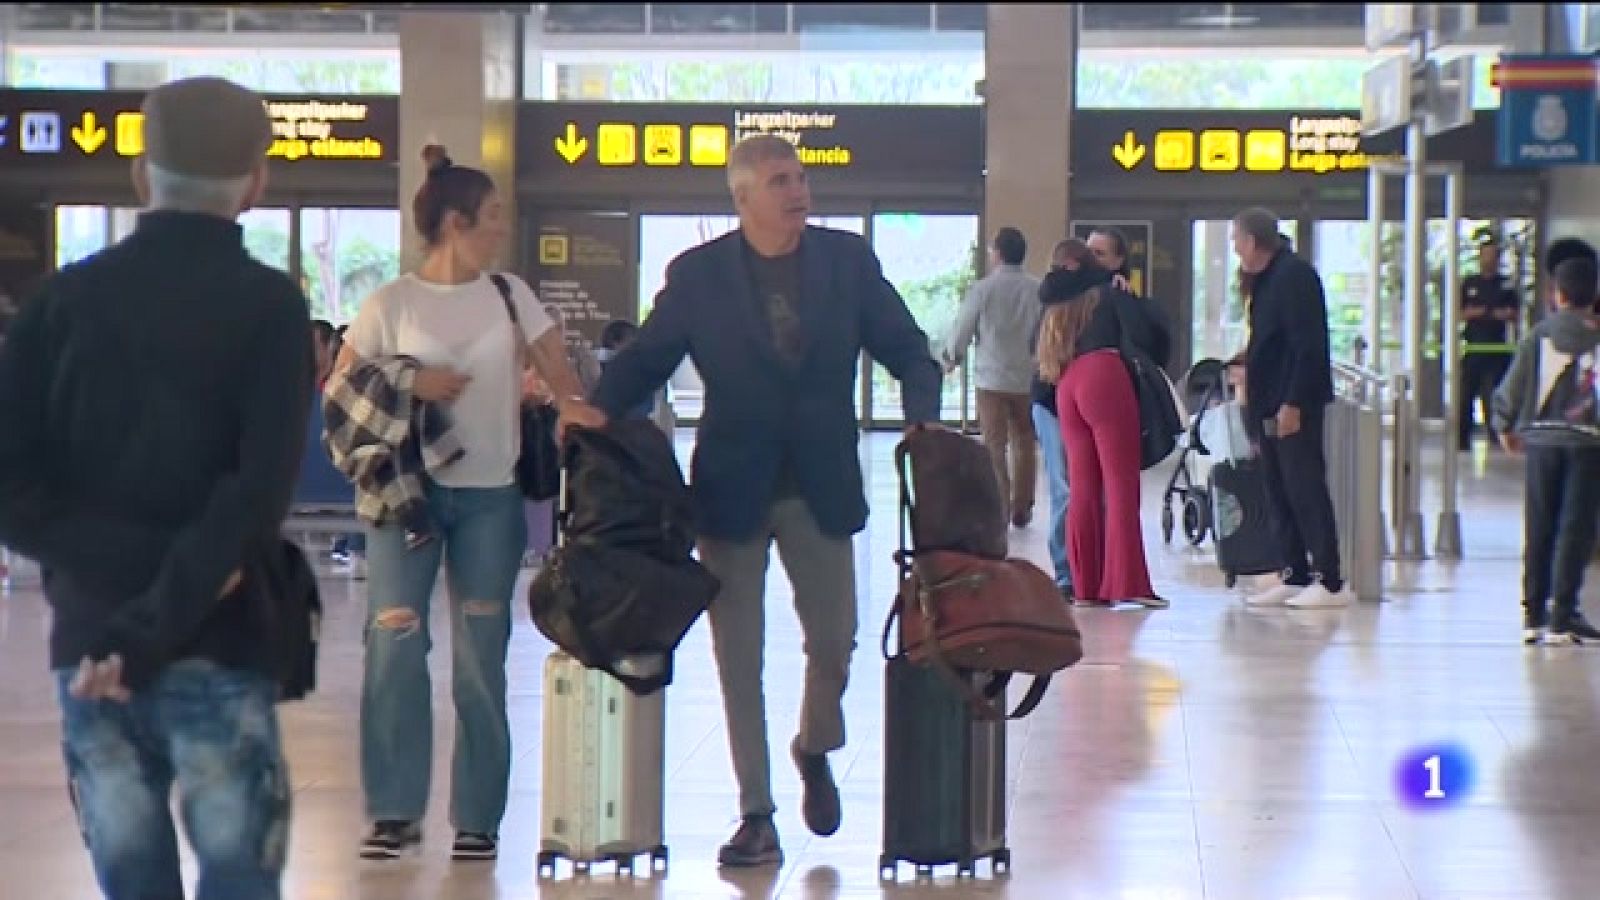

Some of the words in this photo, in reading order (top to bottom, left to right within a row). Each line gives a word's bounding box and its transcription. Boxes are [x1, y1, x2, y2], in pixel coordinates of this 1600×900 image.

[311, 137, 381, 157] estancia
[1290, 134, 1325, 152] Long
[1290, 151, 1335, 172] Larga
